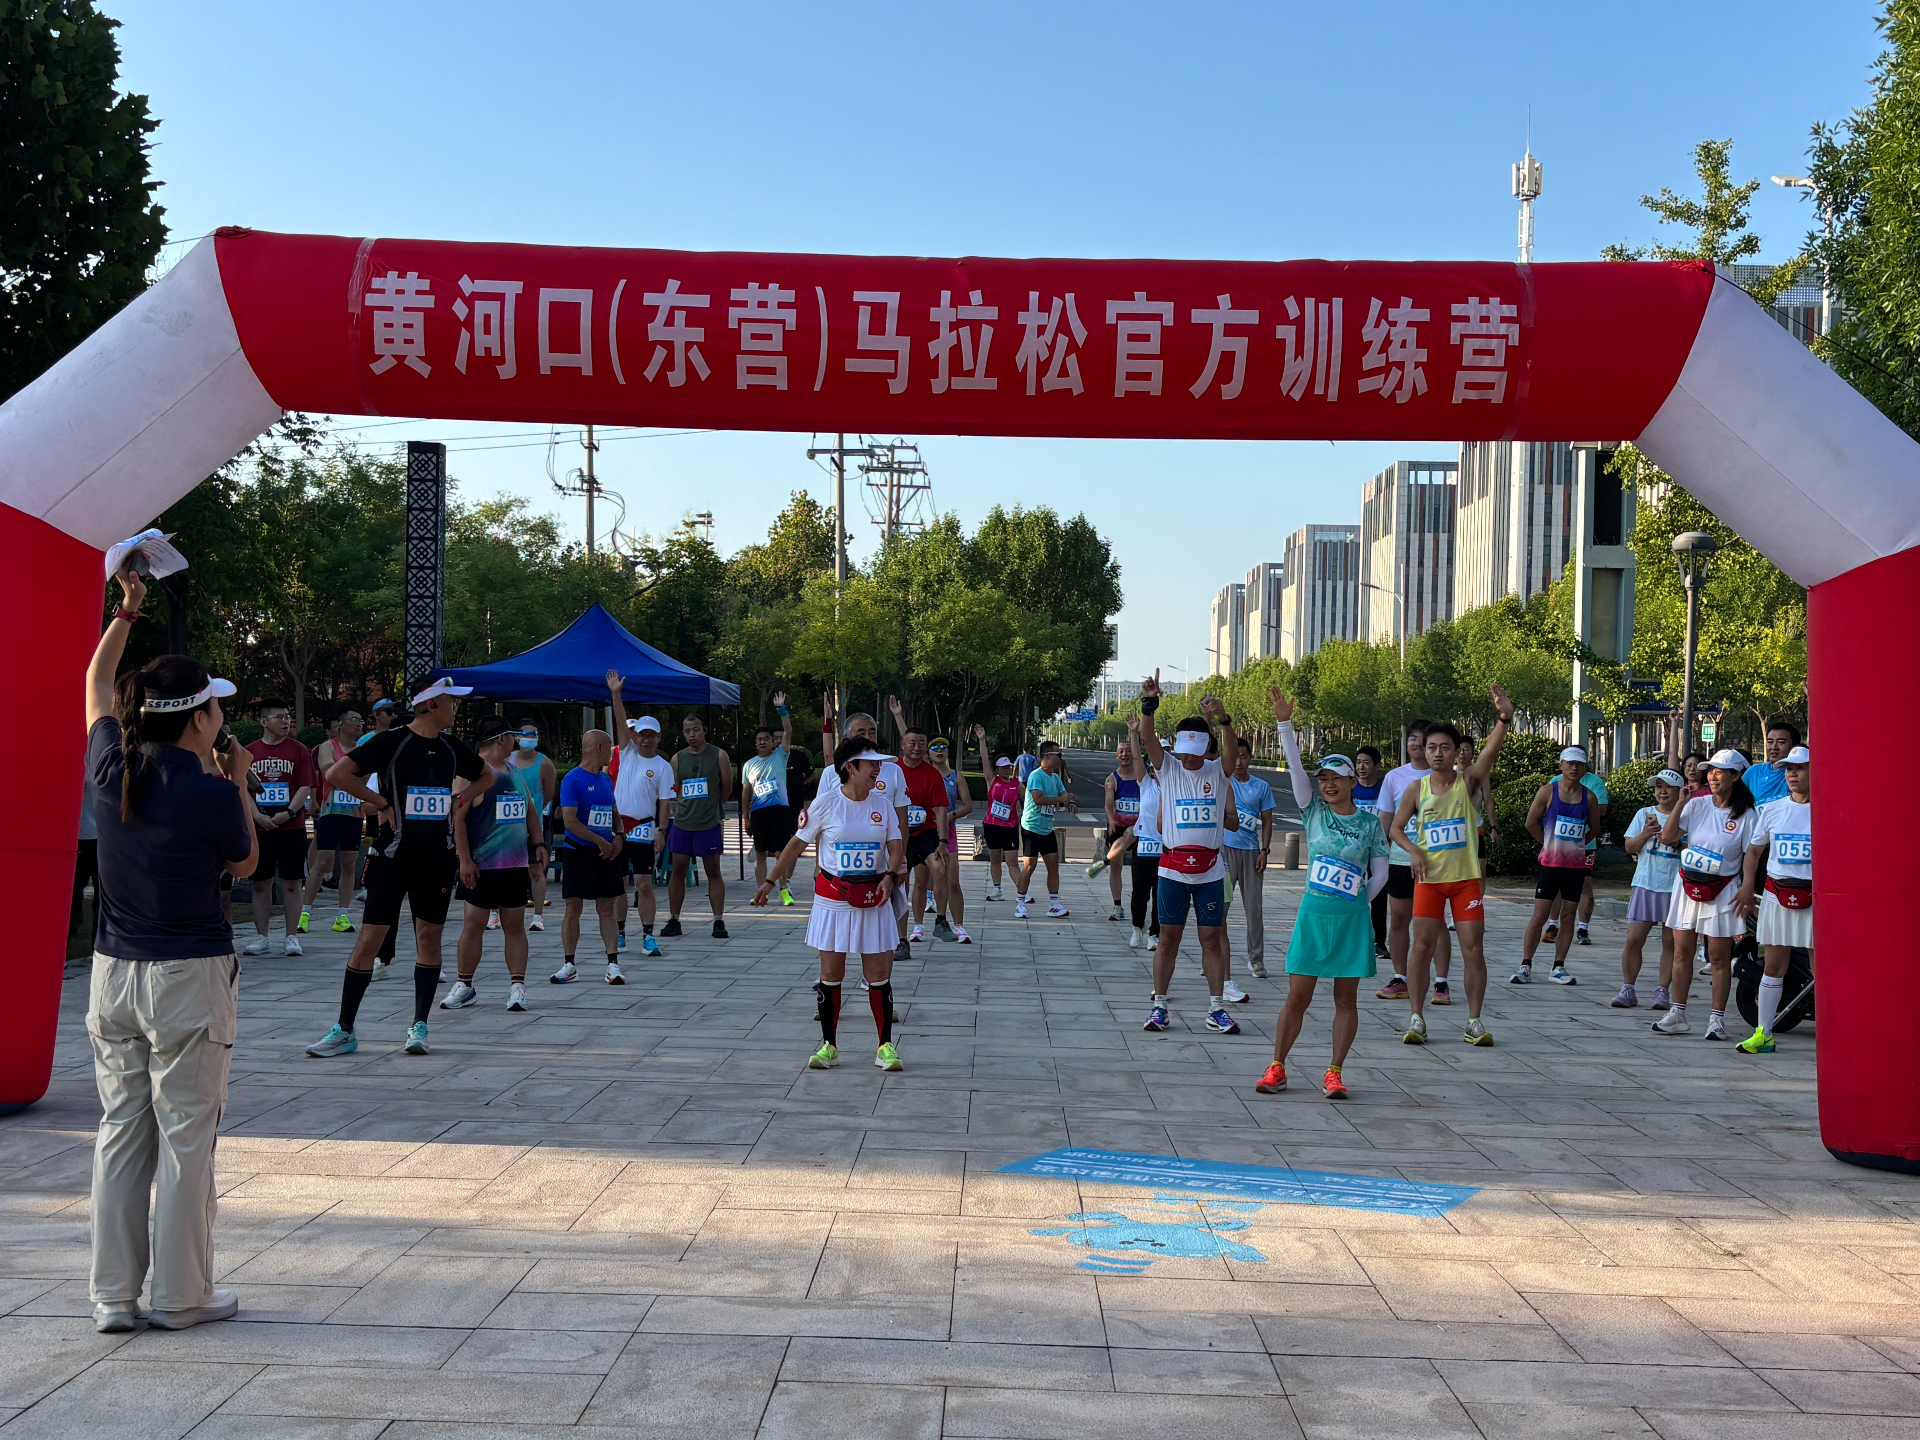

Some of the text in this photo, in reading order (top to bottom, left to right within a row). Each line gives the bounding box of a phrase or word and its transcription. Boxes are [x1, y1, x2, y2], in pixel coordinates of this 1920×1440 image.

[365, 271, 1519, 404] 黄河口(东营)马拉松官方训练营
[260, 789, 285, 801] 085
[684, 784, 704, 795] 078
[413, 796, 445, 814] 081
[503, 803, 525, 817] 037
[1118, 801, 1135, 811] 051
[908, 812, 921, 823] 66
[1181, 807, 1210, 821] 013
[1238, 812, 1253, 827] 84
[1430, 826, 1460, 844] 071
[1560, 823, 1583, 837] 067
[1142, 842, 1160, 853] 107
[1779, 842, 1811, 858] 055
[841, 852, 874, 869] 065
[1684, 851, 1712, 872] 061
[1317, 865, 1355, 891] 045
